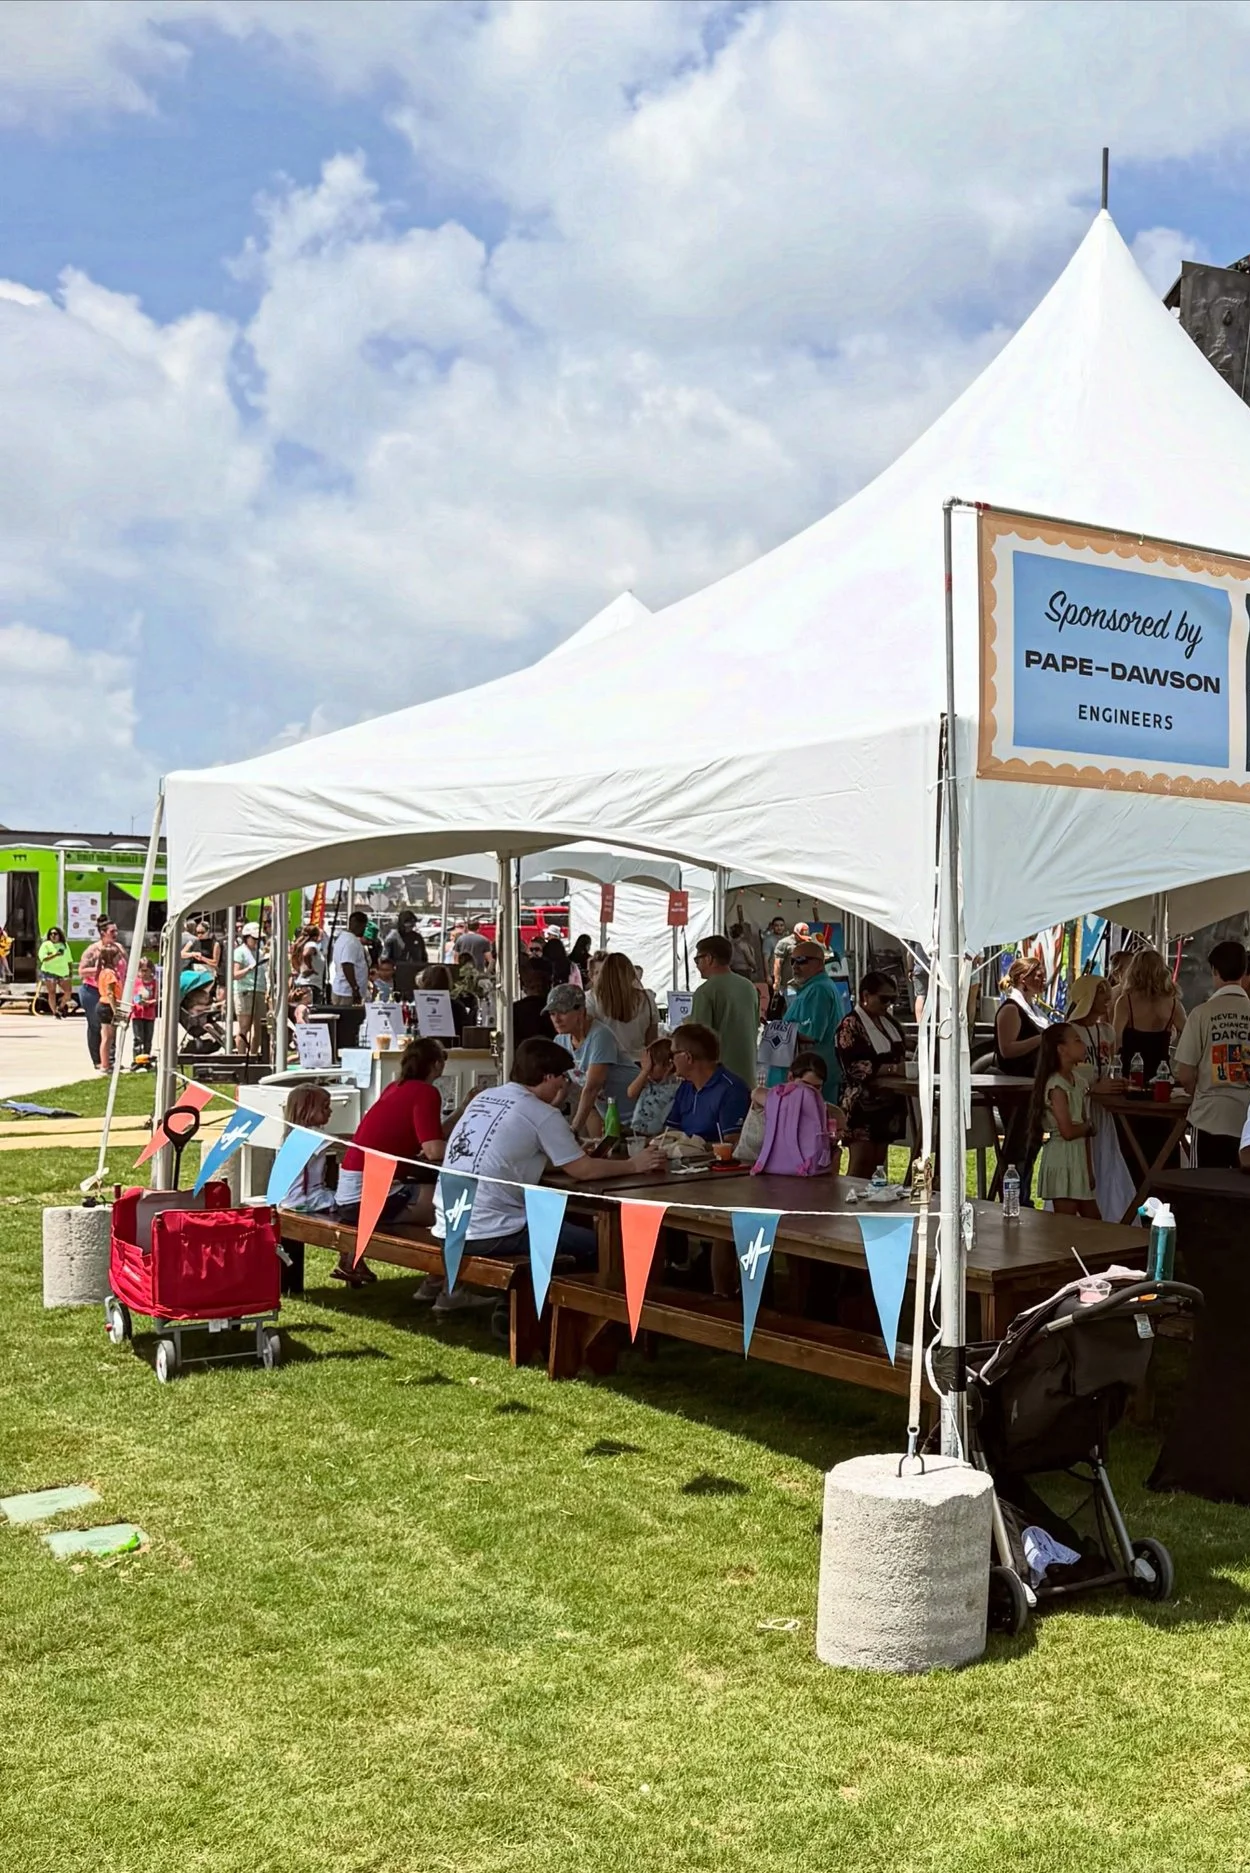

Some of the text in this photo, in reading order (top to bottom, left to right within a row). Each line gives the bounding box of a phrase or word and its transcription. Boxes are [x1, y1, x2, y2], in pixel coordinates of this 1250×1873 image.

[1044, 590, 1203, 660] Sponsored by
[1024, 649, 1221, 694] PAPE-DAWSON
[1077, 704, 1174, 731] ENGINEERS
[1211, 1012, 1238, 1022] NEVER
[1219, 1021, 1249, 1030] CHANCE
